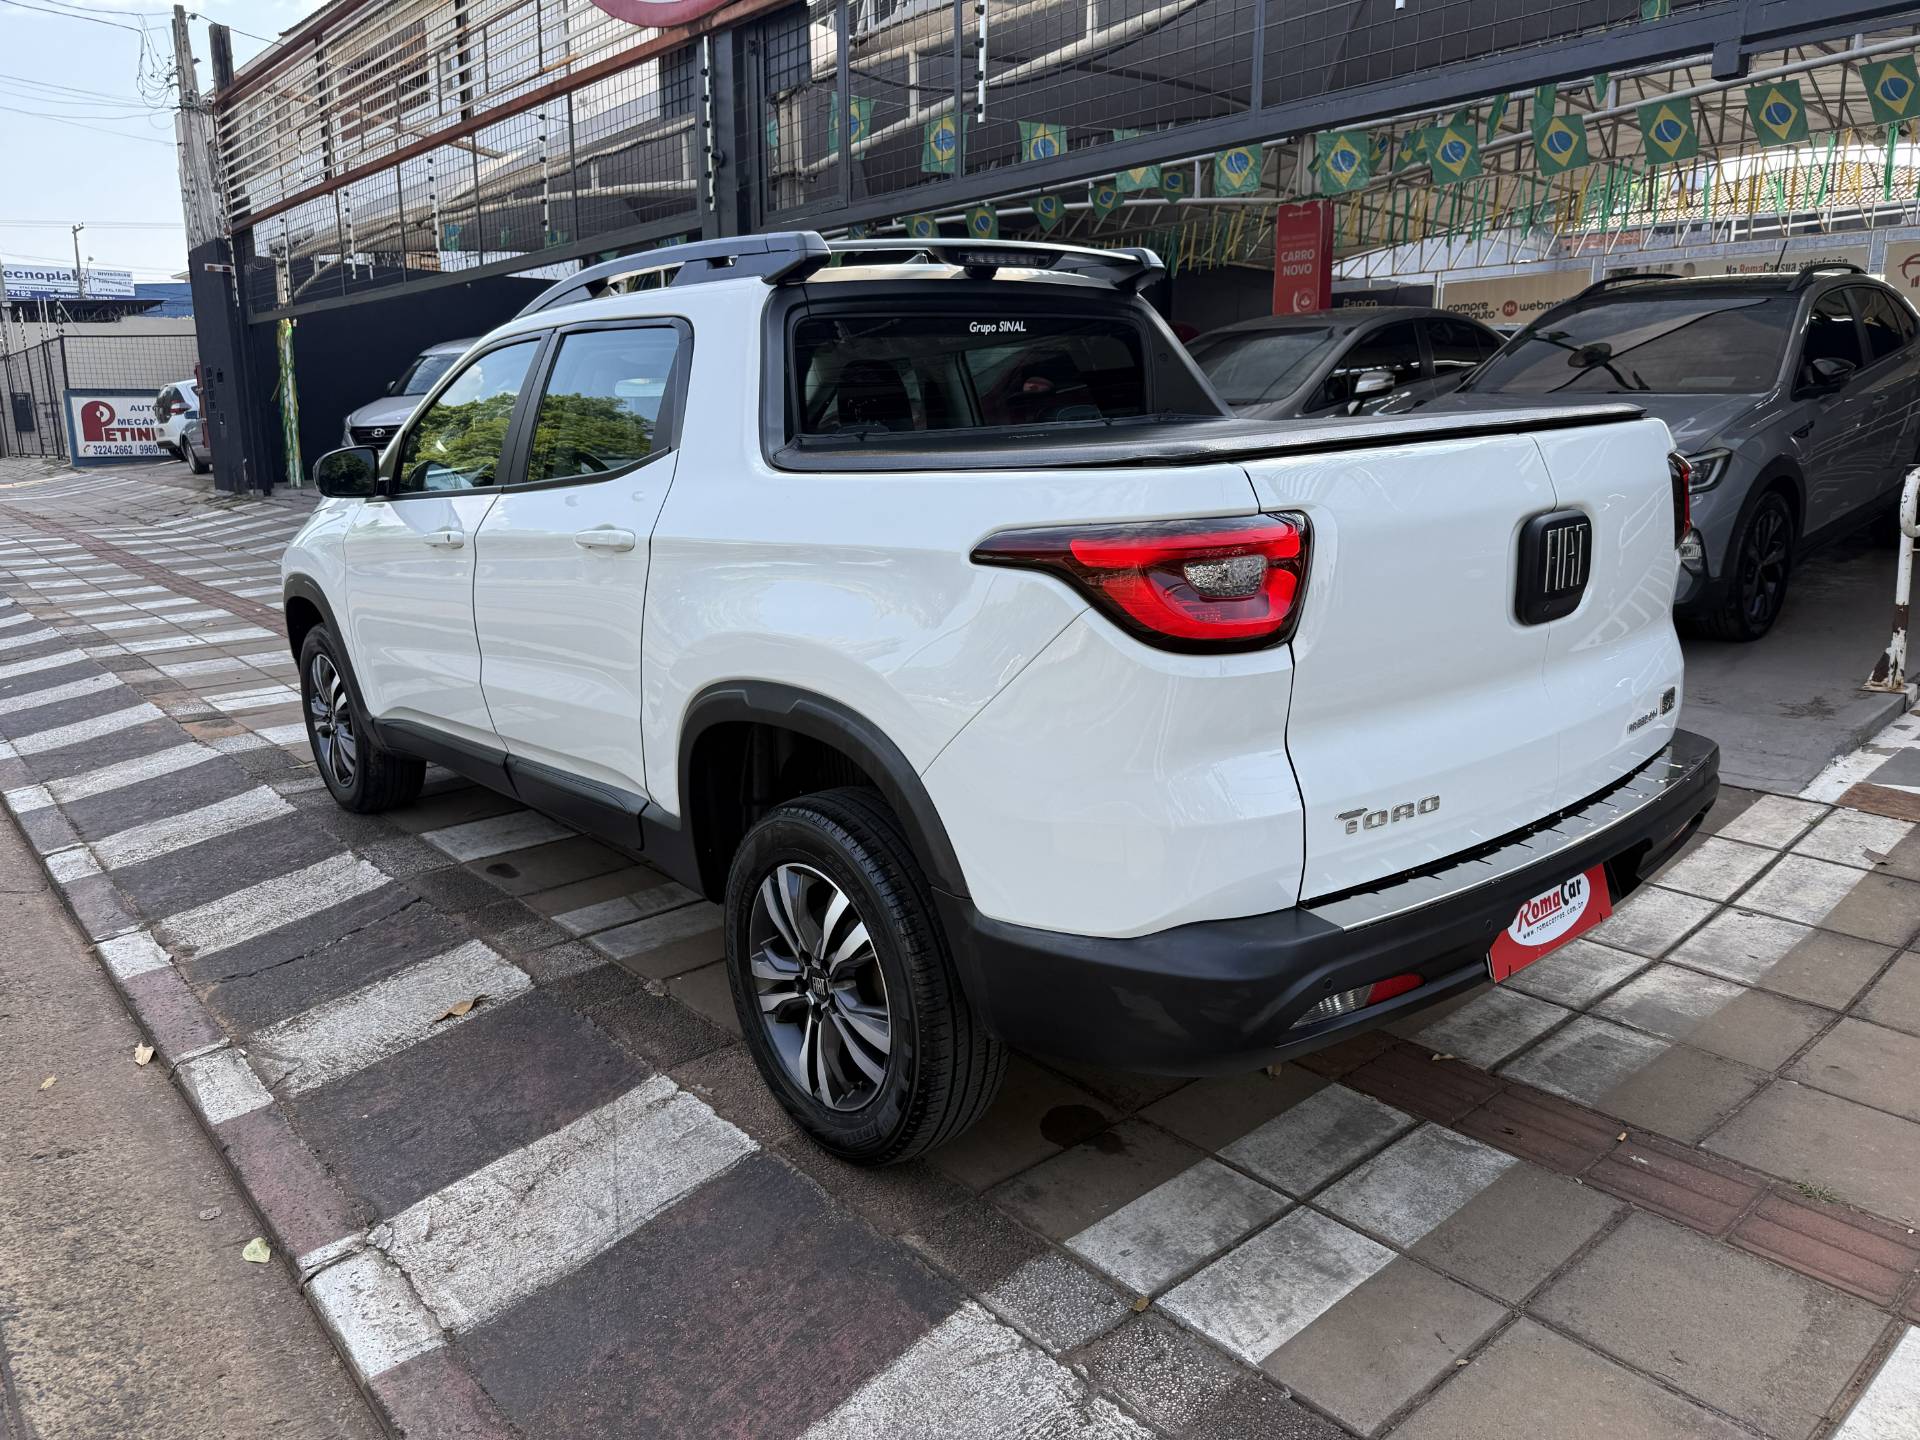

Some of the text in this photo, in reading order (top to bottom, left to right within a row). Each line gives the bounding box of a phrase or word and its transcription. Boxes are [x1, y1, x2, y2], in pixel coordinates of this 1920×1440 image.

[1281, 249, 1315, 263] CARRO
[1283, 263, 1312, 276] NOVO
[1726, 264, 1737, 274] Na
[1781, 262, 1797, 272] sua
[1446, 301, 1488, 312] compre
[970, 321, 1027, 335] Grupo SINAL
[93, 445, 133, 455] 3224.2662
[1334, 795, 1440, 835] TORO
[1517, 878, 1581, 933] RomaCar
